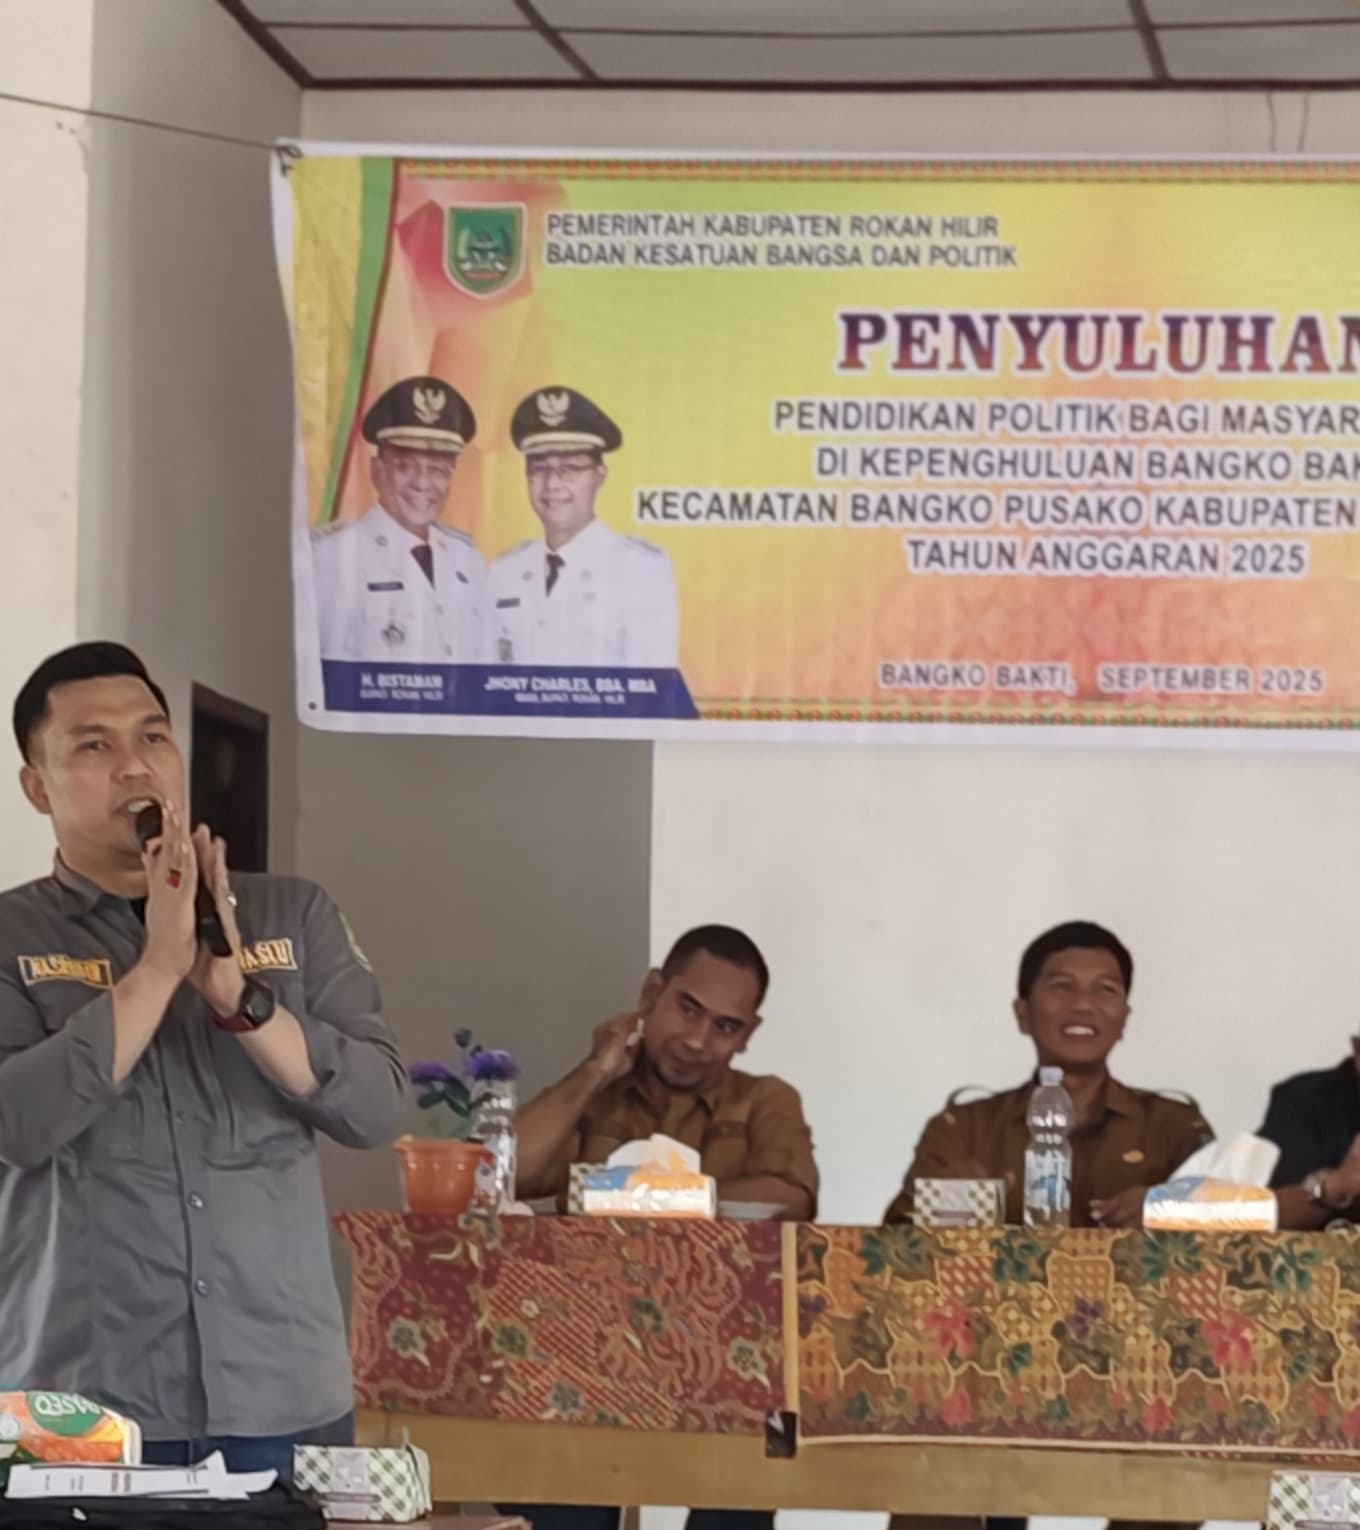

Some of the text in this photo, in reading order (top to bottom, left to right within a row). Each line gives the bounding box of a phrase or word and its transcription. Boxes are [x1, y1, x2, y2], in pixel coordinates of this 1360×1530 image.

[546, 213, 999, 239] PEMERINTAH KABUPATEN ROKAN HILIR
[545, 242, 1018, 268] BADAN KESATUAN BANGSA DAN POLITIK
[773, 400, 976, 431] PENDIDIKAN
[987, 402, 1118, 432] POLITIK
[1128, 404, 1210, 433] BAGI
[817, 446, 848, 477] DI
[859, 447, 1135, 479] KEPENGHULUAN
[1146, 450, 1292, 480] BANGKO
[636, 490, 838, 522] KECAMATAN
[849, 492, 994, 524] BANGKO
[1003, 494, 1144, 526] PUSAKO
[1154, 496, 1358, 528] KABUPATEN
[907, 539, 1305, 574] TAHUN ANGGARAN 2025
[880, 663, 1324, 692] BANGKO BAKTI, SEPTEMBER 2025
[34, 1391, 102, 1417] PASEO
